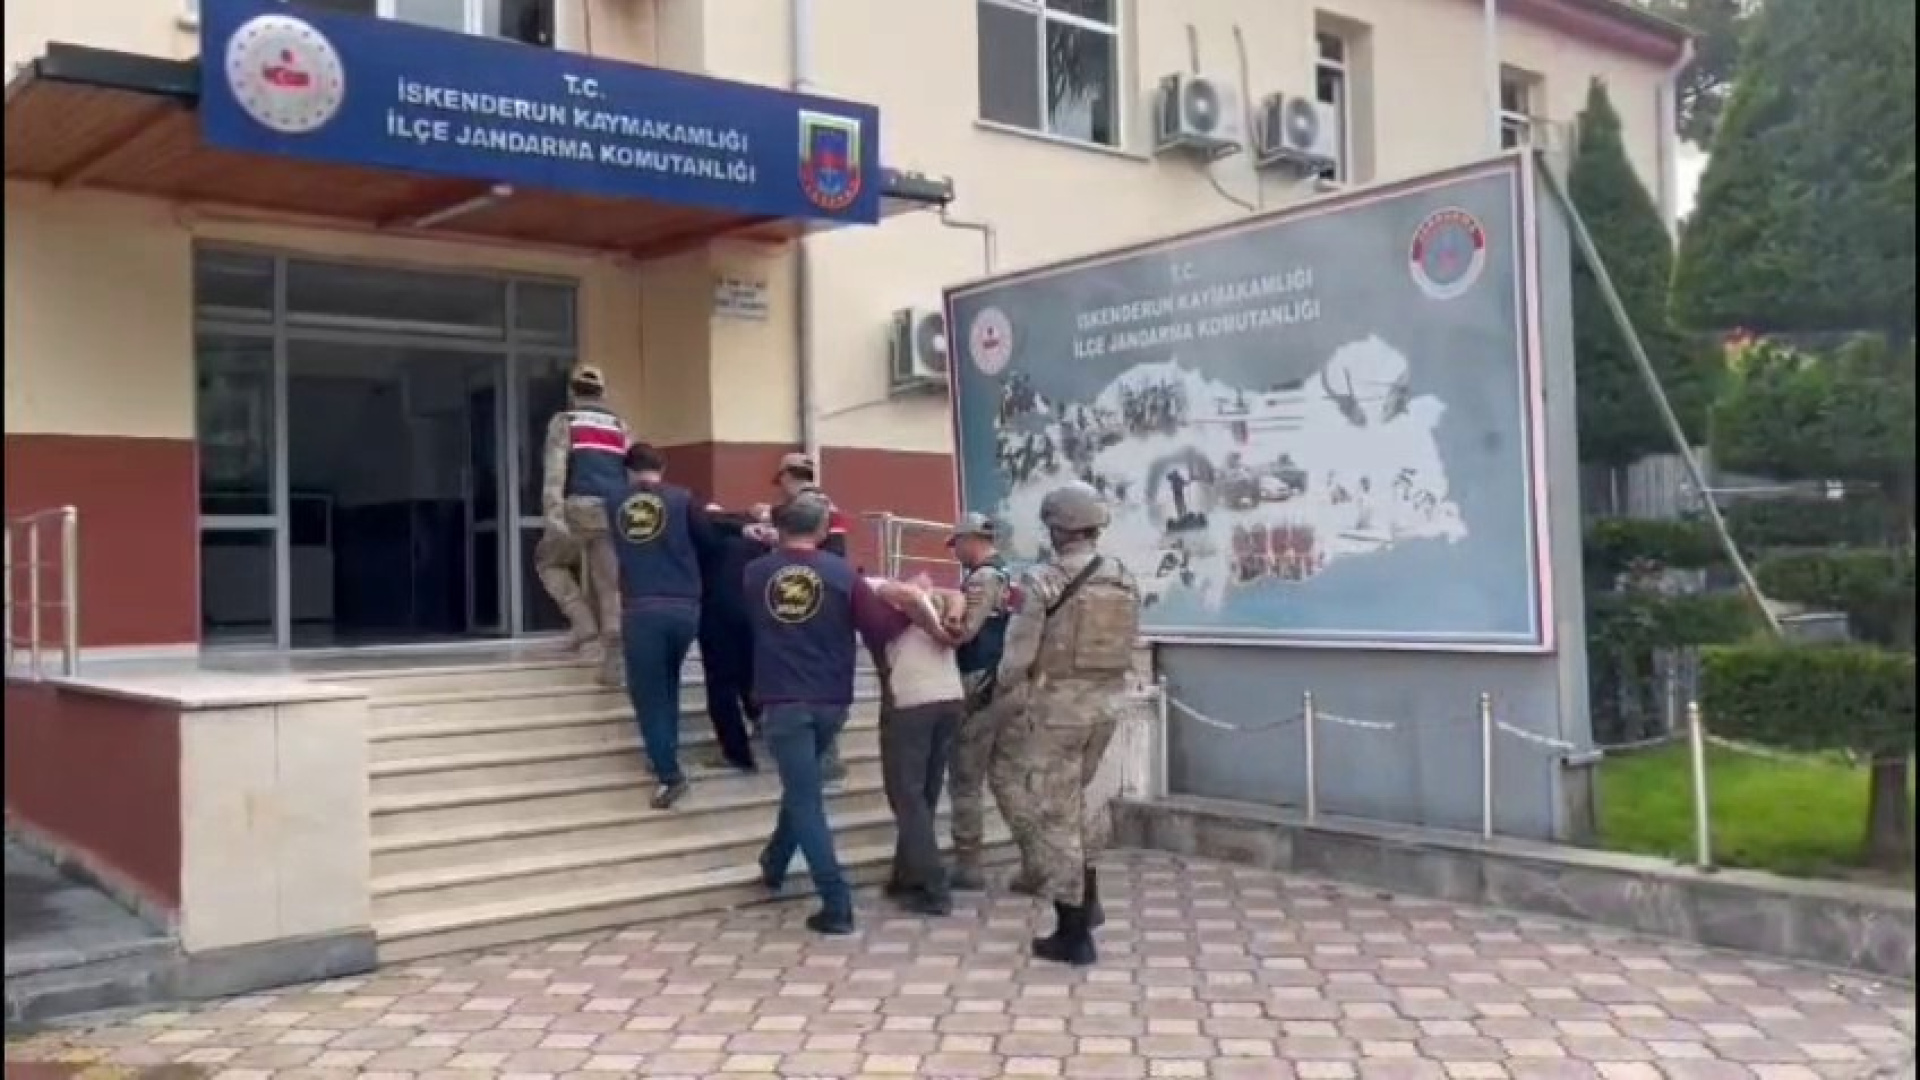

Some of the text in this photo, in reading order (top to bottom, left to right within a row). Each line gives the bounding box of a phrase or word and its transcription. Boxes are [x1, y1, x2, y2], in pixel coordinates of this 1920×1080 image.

[398, 75, 748, 153] İSKENDERUN KAYMAKAMLIĞI
[563, 74, 607, 99] T.C.
[387, 107, 757, 184] İLÇE JANDARMA KOMUTANLIĞI
